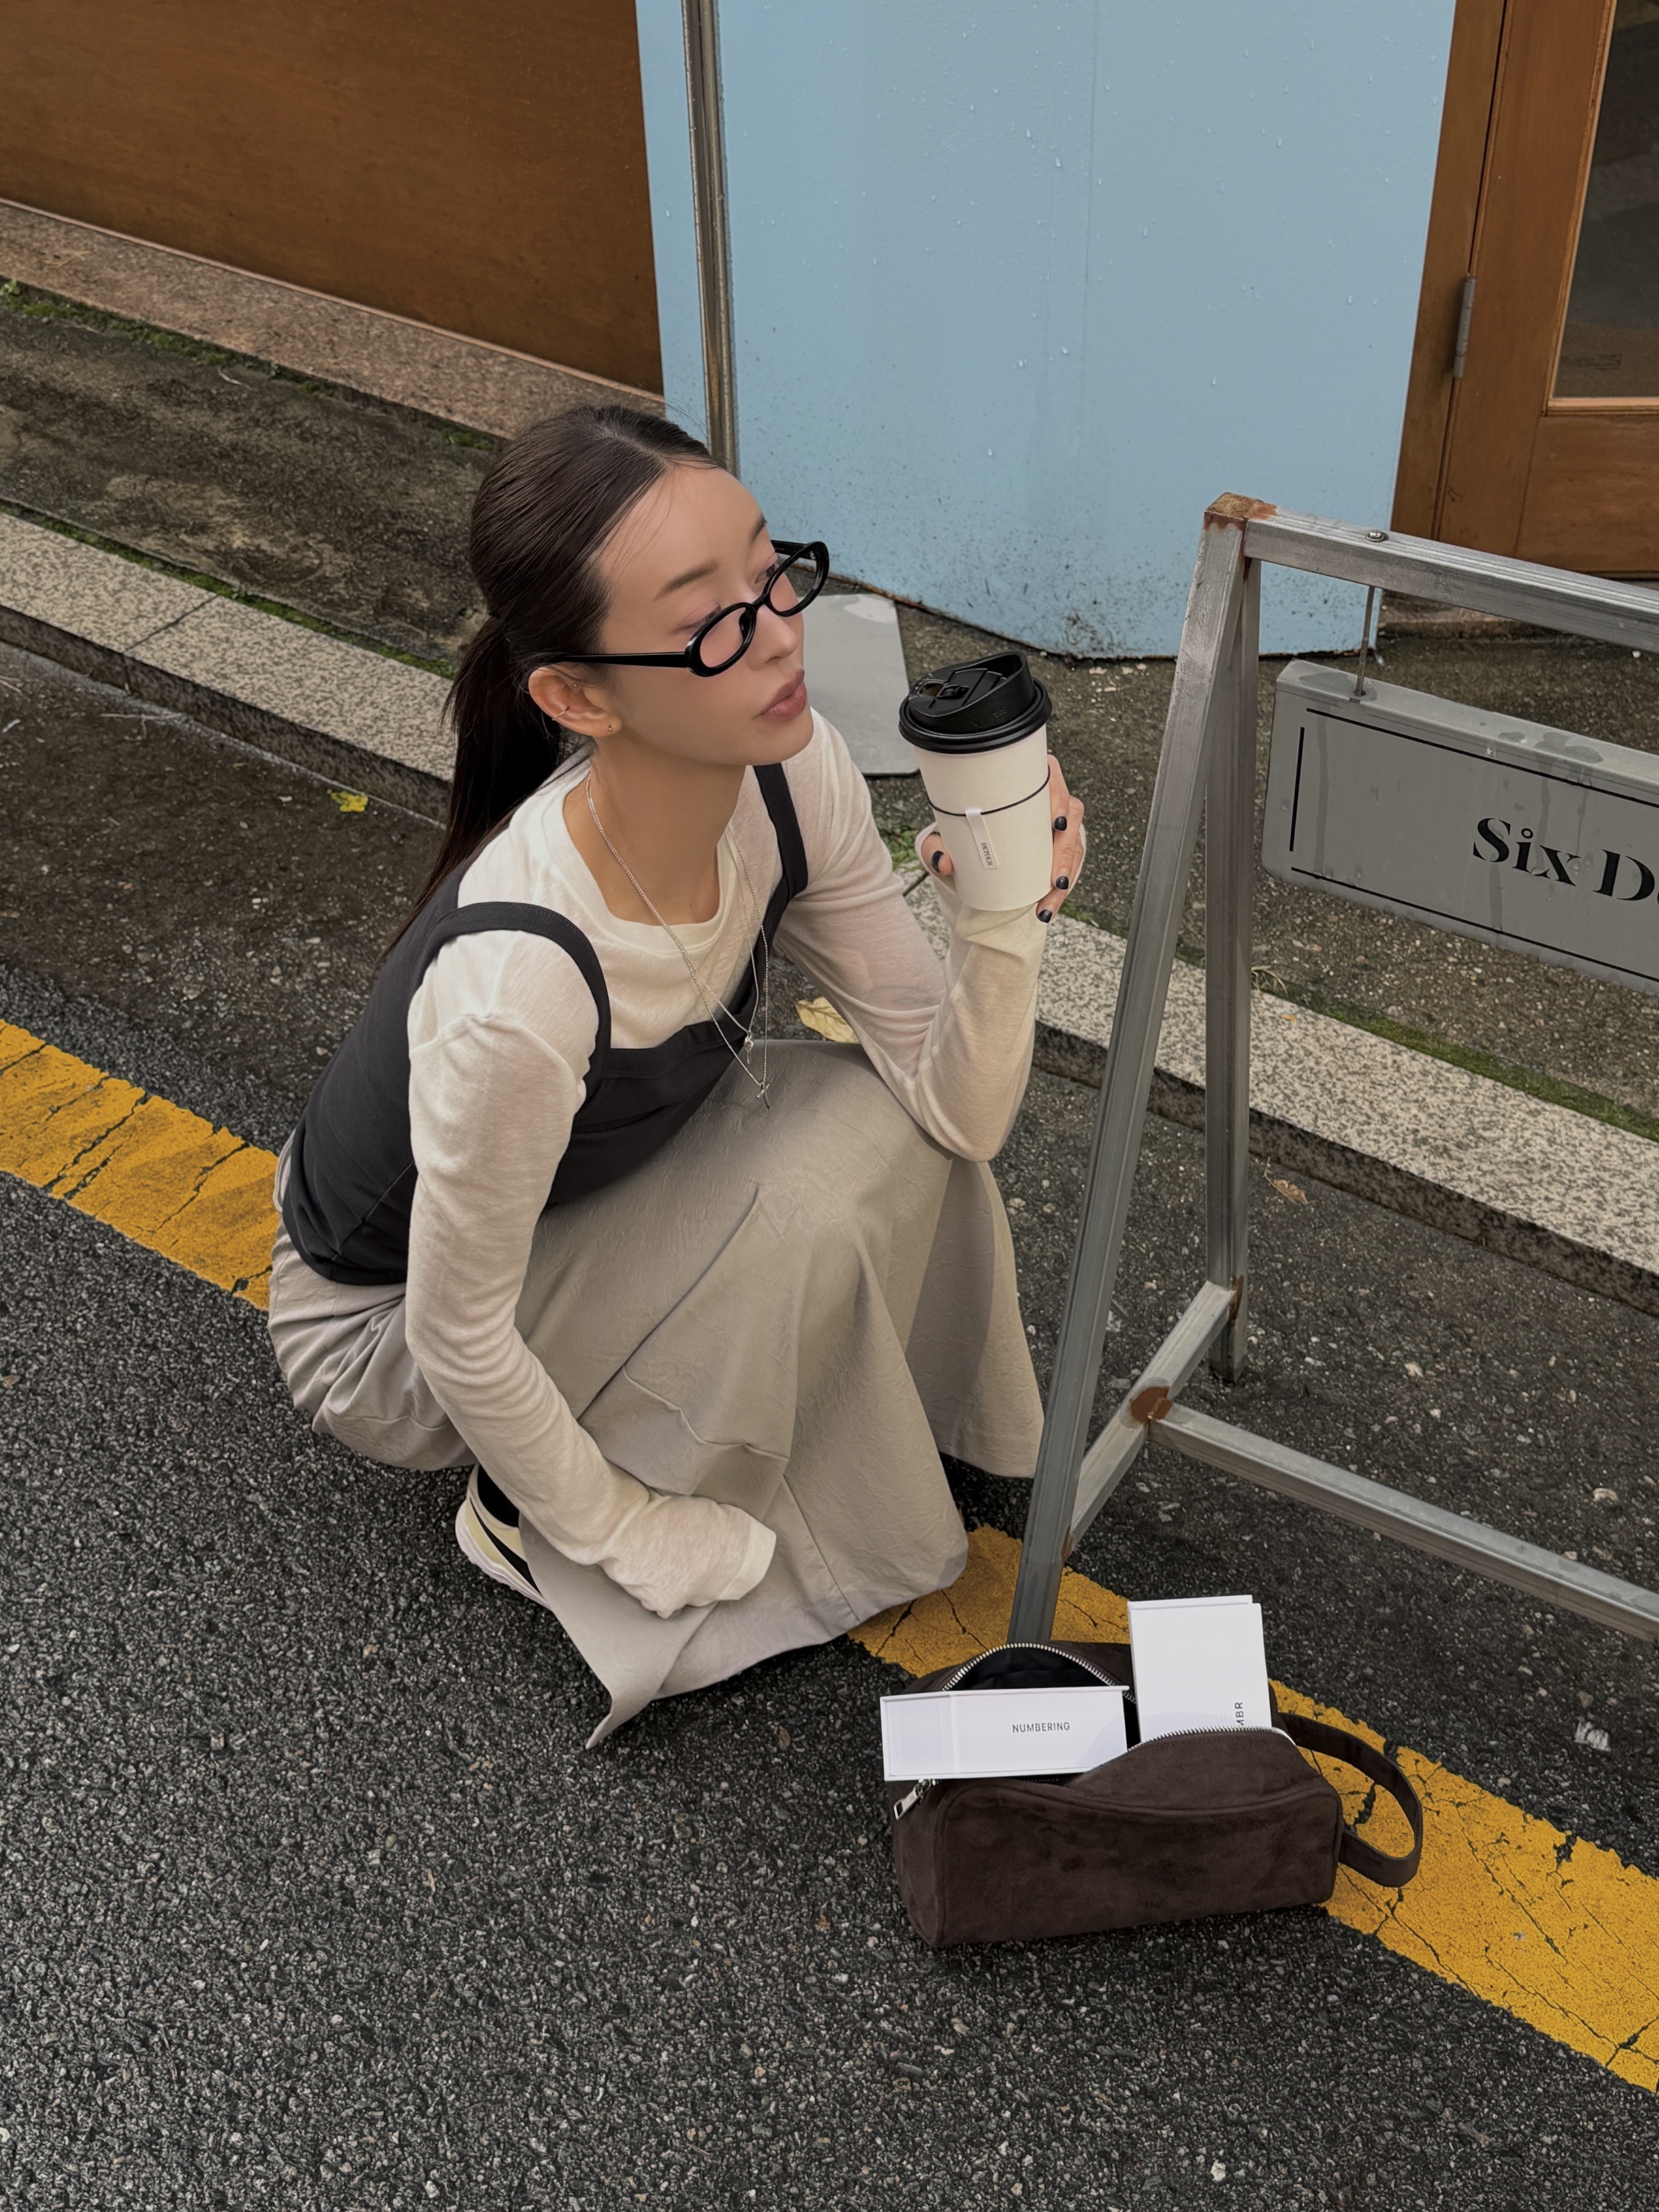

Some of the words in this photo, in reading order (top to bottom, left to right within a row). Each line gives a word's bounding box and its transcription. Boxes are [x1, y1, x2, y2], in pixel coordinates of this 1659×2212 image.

[1473, 817, 1581, 887] Six
[1592, 848, 1659, 906] D
[1012, 1722, 1070, 1733] NUMBERING
